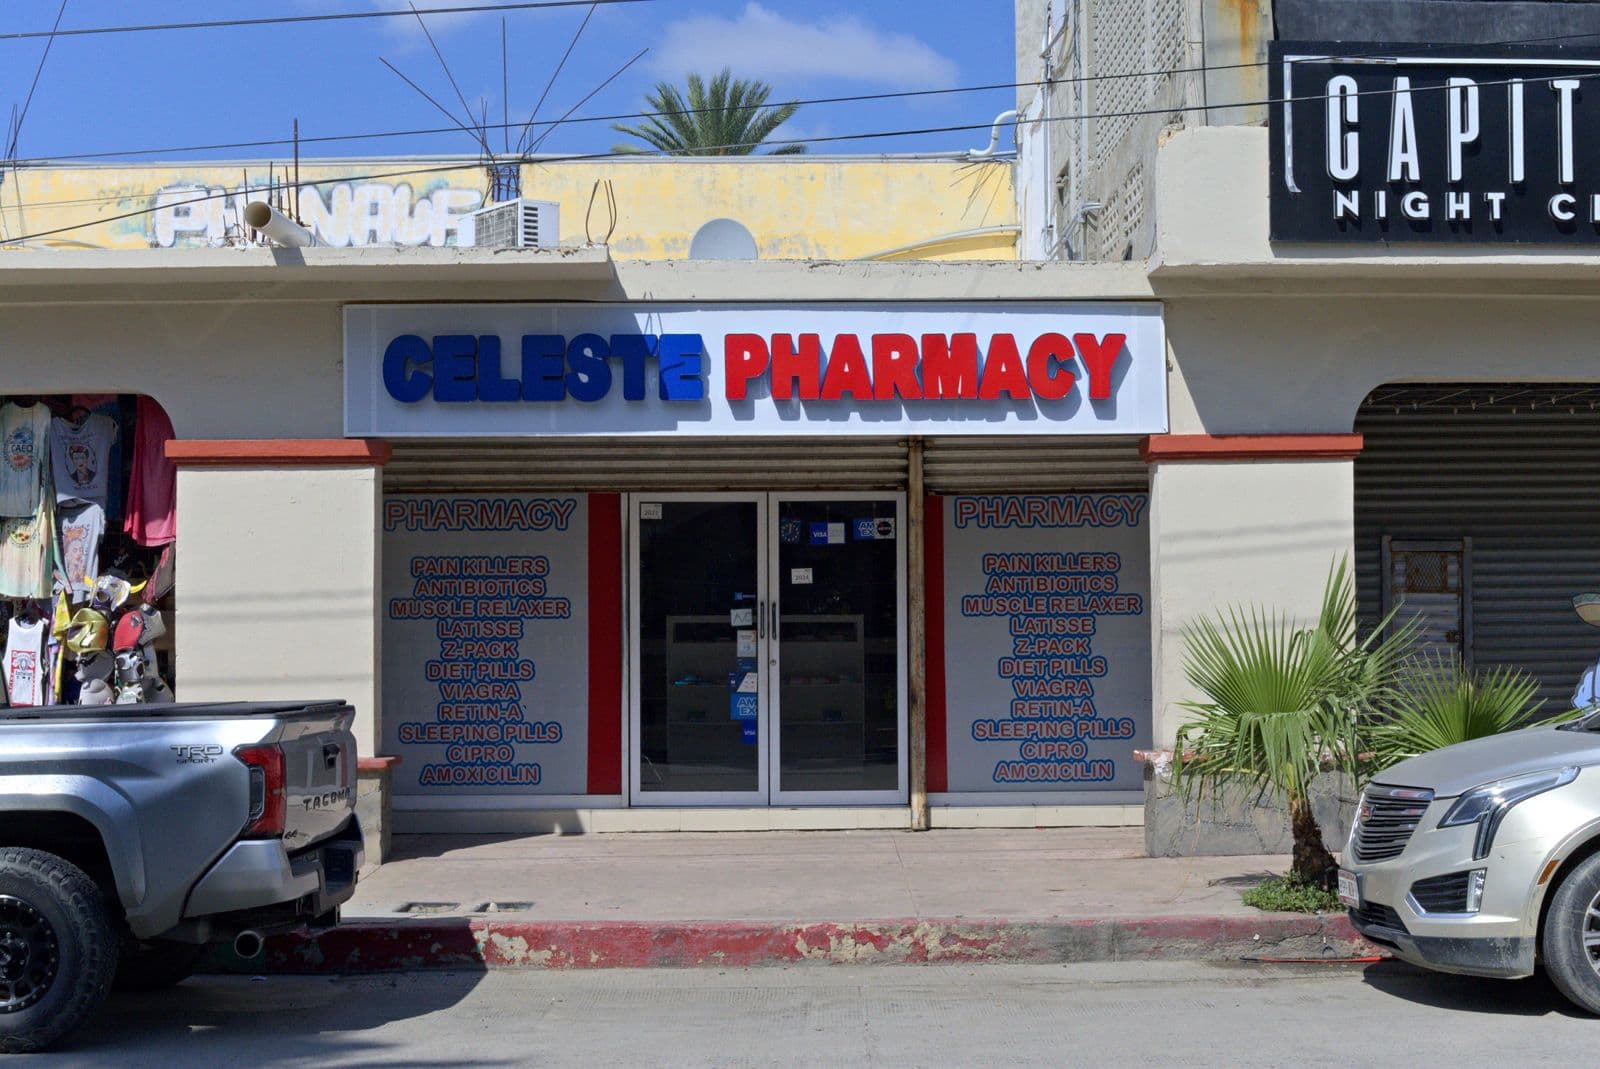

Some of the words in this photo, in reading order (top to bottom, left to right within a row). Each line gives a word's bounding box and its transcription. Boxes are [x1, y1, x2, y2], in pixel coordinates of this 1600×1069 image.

[1326, 75, 1580, 184] CAPIT
[1333, 190, 1505, 221] NIGHT
[383, 333, 704, 402] CELESTE
[725, 333, 1126, 399] PHARMACY
[385, 499, 575, 530] PHARMACY
[956, 497, 1145, 527] PHARMACY
[412, 558, 459, 576] PAIN
[462, 558, 548, 576] KILLERS
[984, 555, 1032, 573] PAIN
[1034, 554, 1119, 572] KILLERS
[414, 578, 545, 596] ANTIBIOTICS
[987, 575, 1117, 593] ANTIBIOTICS
[391, 599, 473, 618] MUSCLE
[477, 599, 569, 617] RELAXER
[963, 596, 1046, 615] MUSCLE
[1049, 596, 1142, 614] RELAXER
[438, 620, 522, 638] LATISSE
[1011, 617, 1095, 635] LATISSE
[443, 641, 518, 659] Z-PACK
[1016, 638, 1090, 656] Z-PACK
[427, 662, 474, 680] DIET
[477, 662, 533, 679] PILLS
[1001, 659, 1048, 676] DIET
[1050, 658, 1106, 676] PILLS
[441, 683, 519, 700] VIAGRA
[1014, 679, 1093, 697] VIAGRA
[439, 703, 522, 721] RETIN-A
[1012, 700, 1095, 717] RETIN-A
[400, 724, 501, 743] SLEEPING
[503, 723, 561, 742] PILLS
[974, 720, 1074, 740] SLEEPING
[1076, 720, 1134, 738] PILLS
[170, 744, 223, 759] TRD
[448, 745, 513, 763] CIPRO
[1021, 741, 1086, 759] CIPRO
[420, 765, 540, 784] AMOXICILIN
[994, 762, 1114, 781] AMOXICILIN
[303, 786, 351, 812] TACOMA
